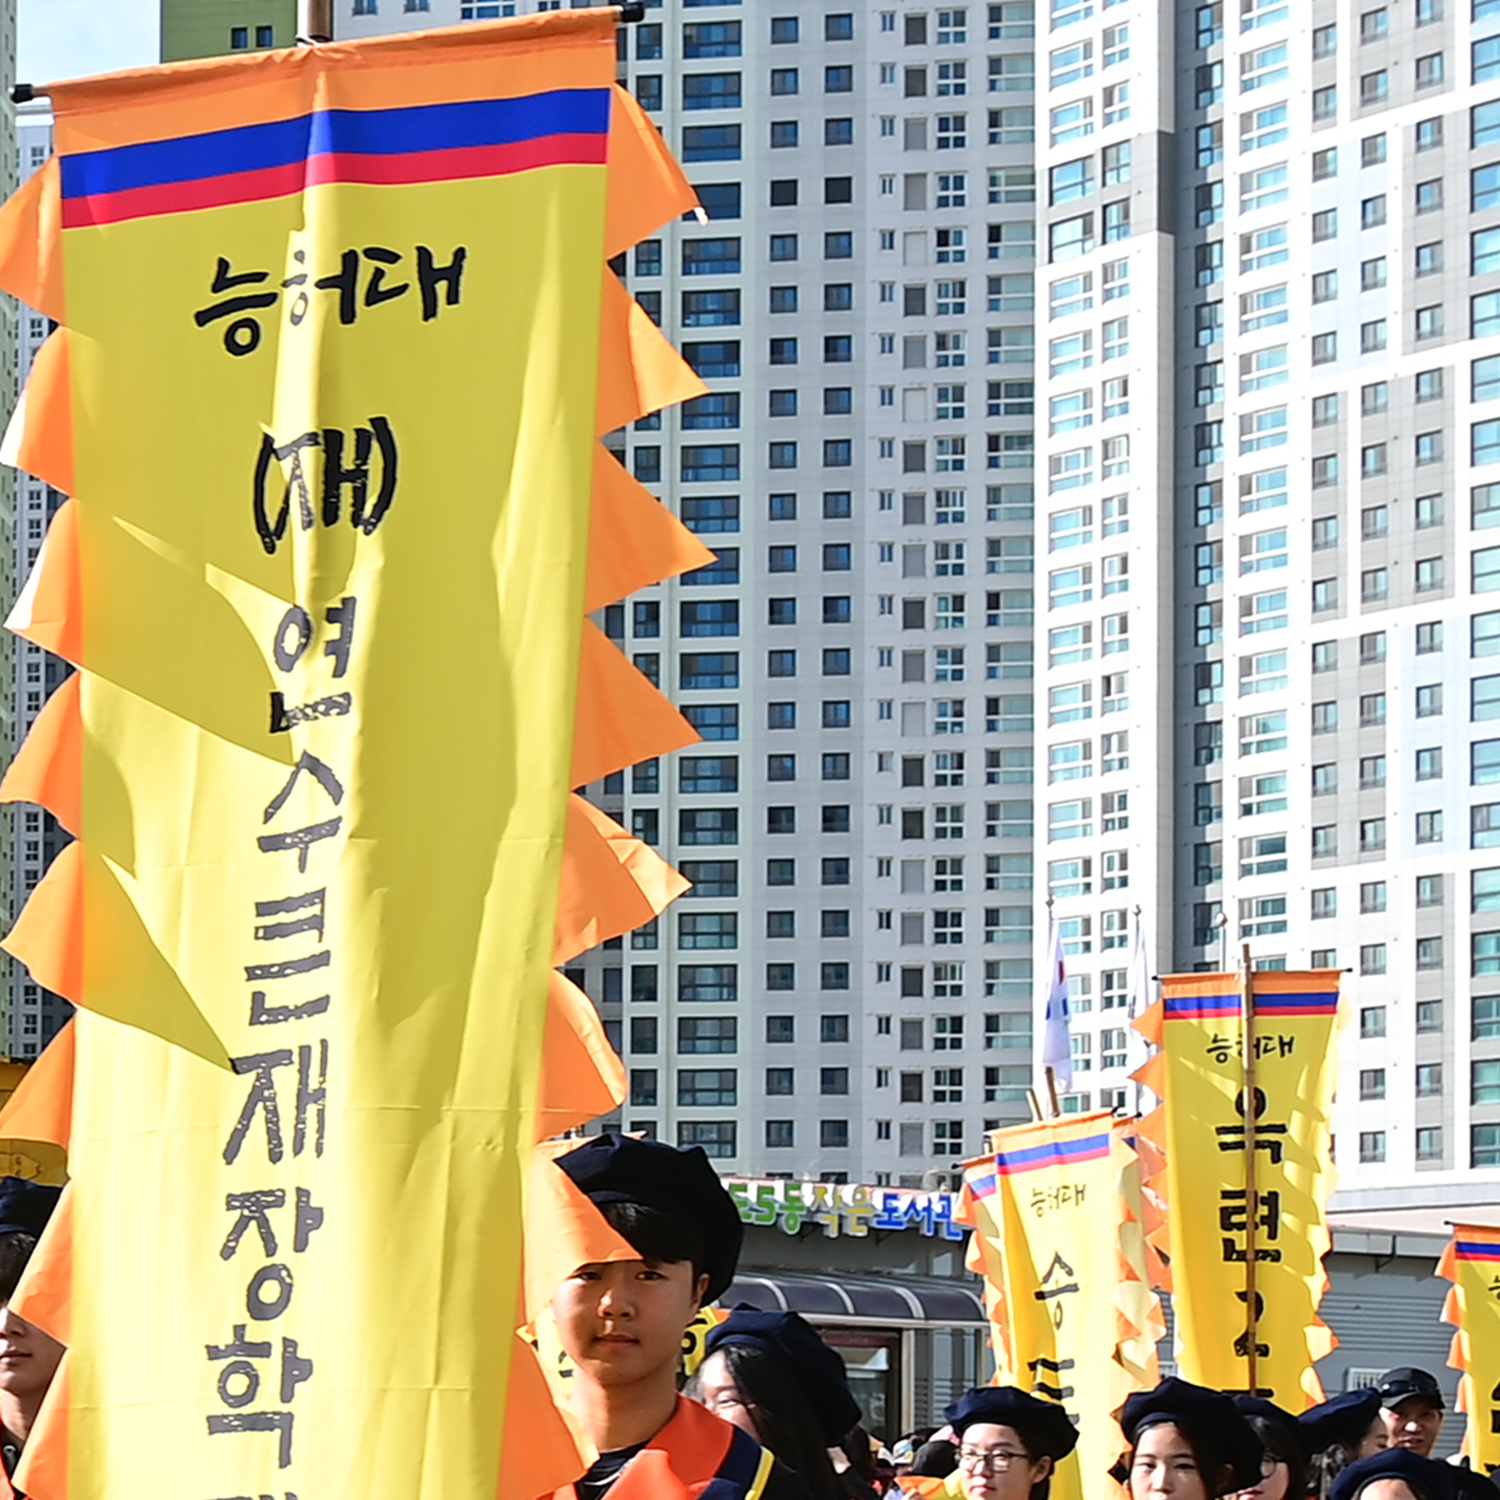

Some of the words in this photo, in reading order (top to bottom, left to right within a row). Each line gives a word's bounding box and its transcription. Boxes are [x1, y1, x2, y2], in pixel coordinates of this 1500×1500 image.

[194, 245, 466, 356] 능허대
[1205, 1034, 1296, 1064] 능허대
[1214, 1086, 1289, 1398] 옥련2
